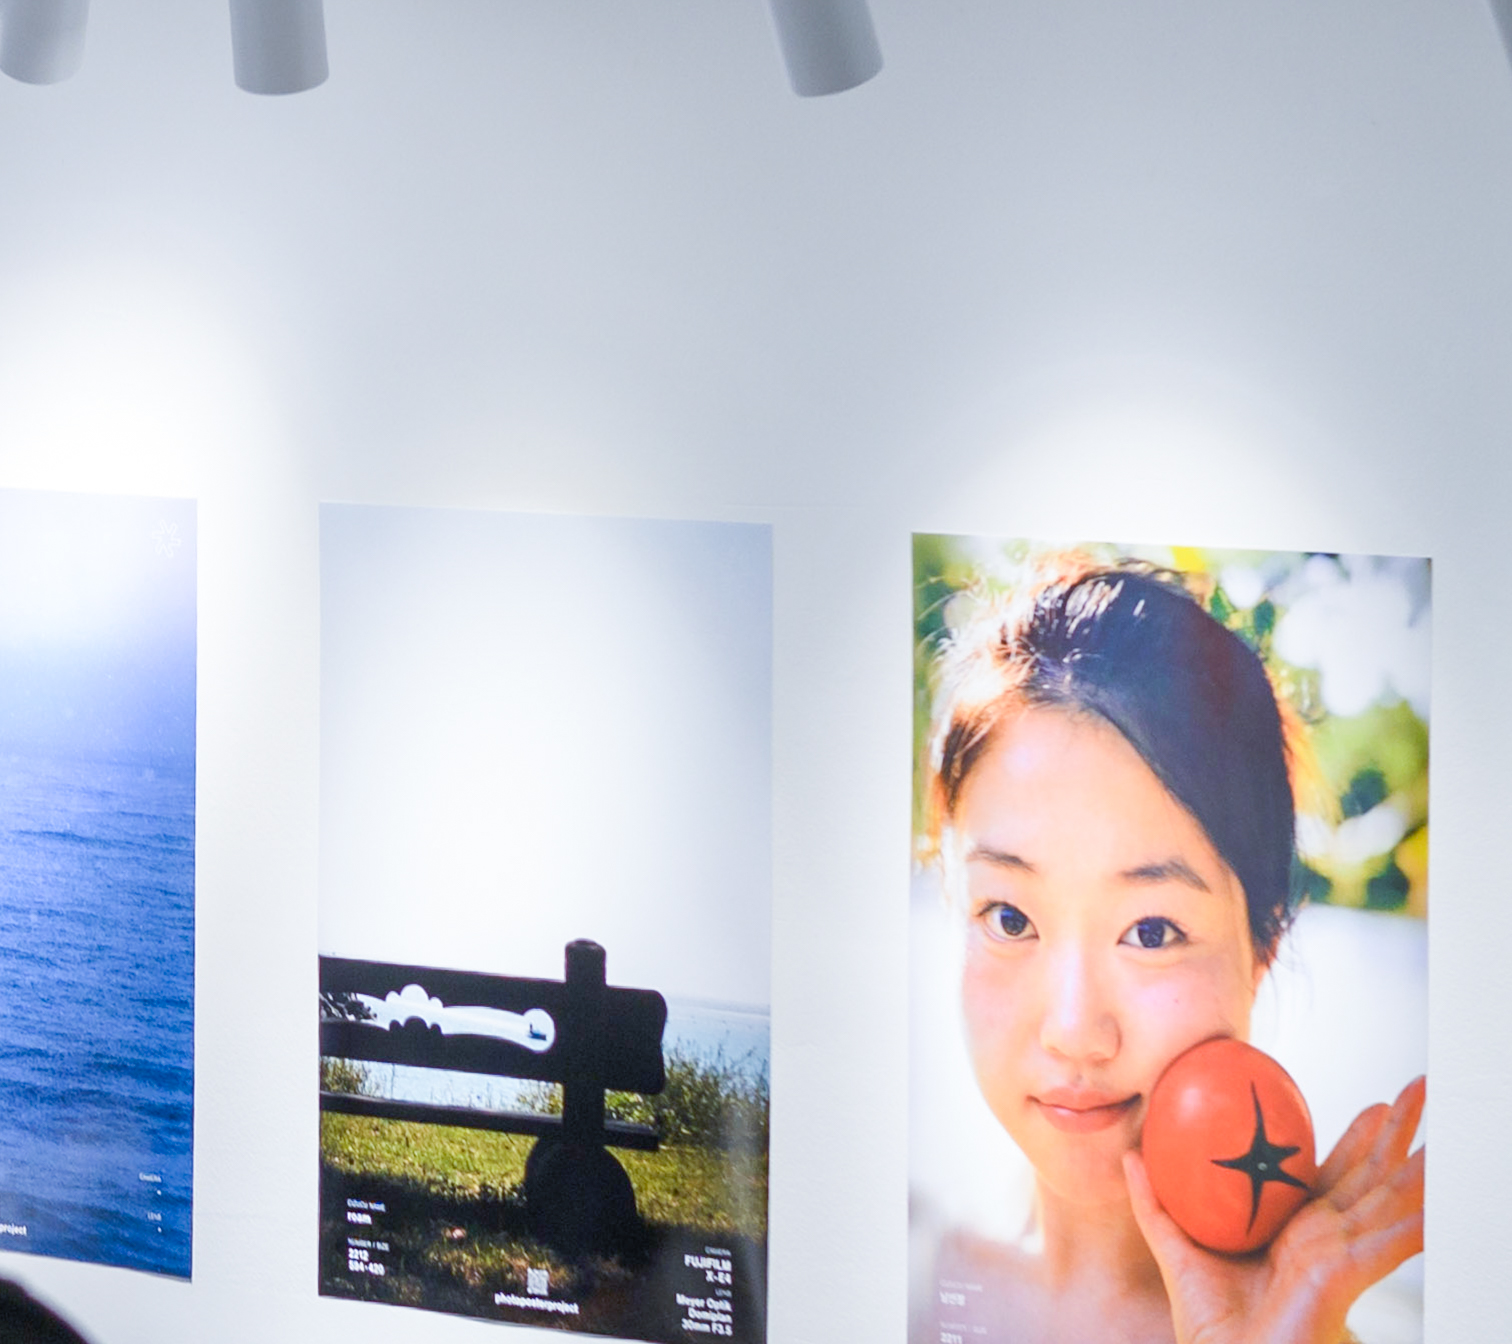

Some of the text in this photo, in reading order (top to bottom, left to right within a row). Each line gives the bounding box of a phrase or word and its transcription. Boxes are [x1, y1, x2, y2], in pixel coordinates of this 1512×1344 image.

[347, 1211, 372, 1225] roam
[684, 1254, 732, 1272] FUJIFILM
[705, 1269, 732, 1285] X-E4
[494, 1292, 579, 1315] photoposterproject
